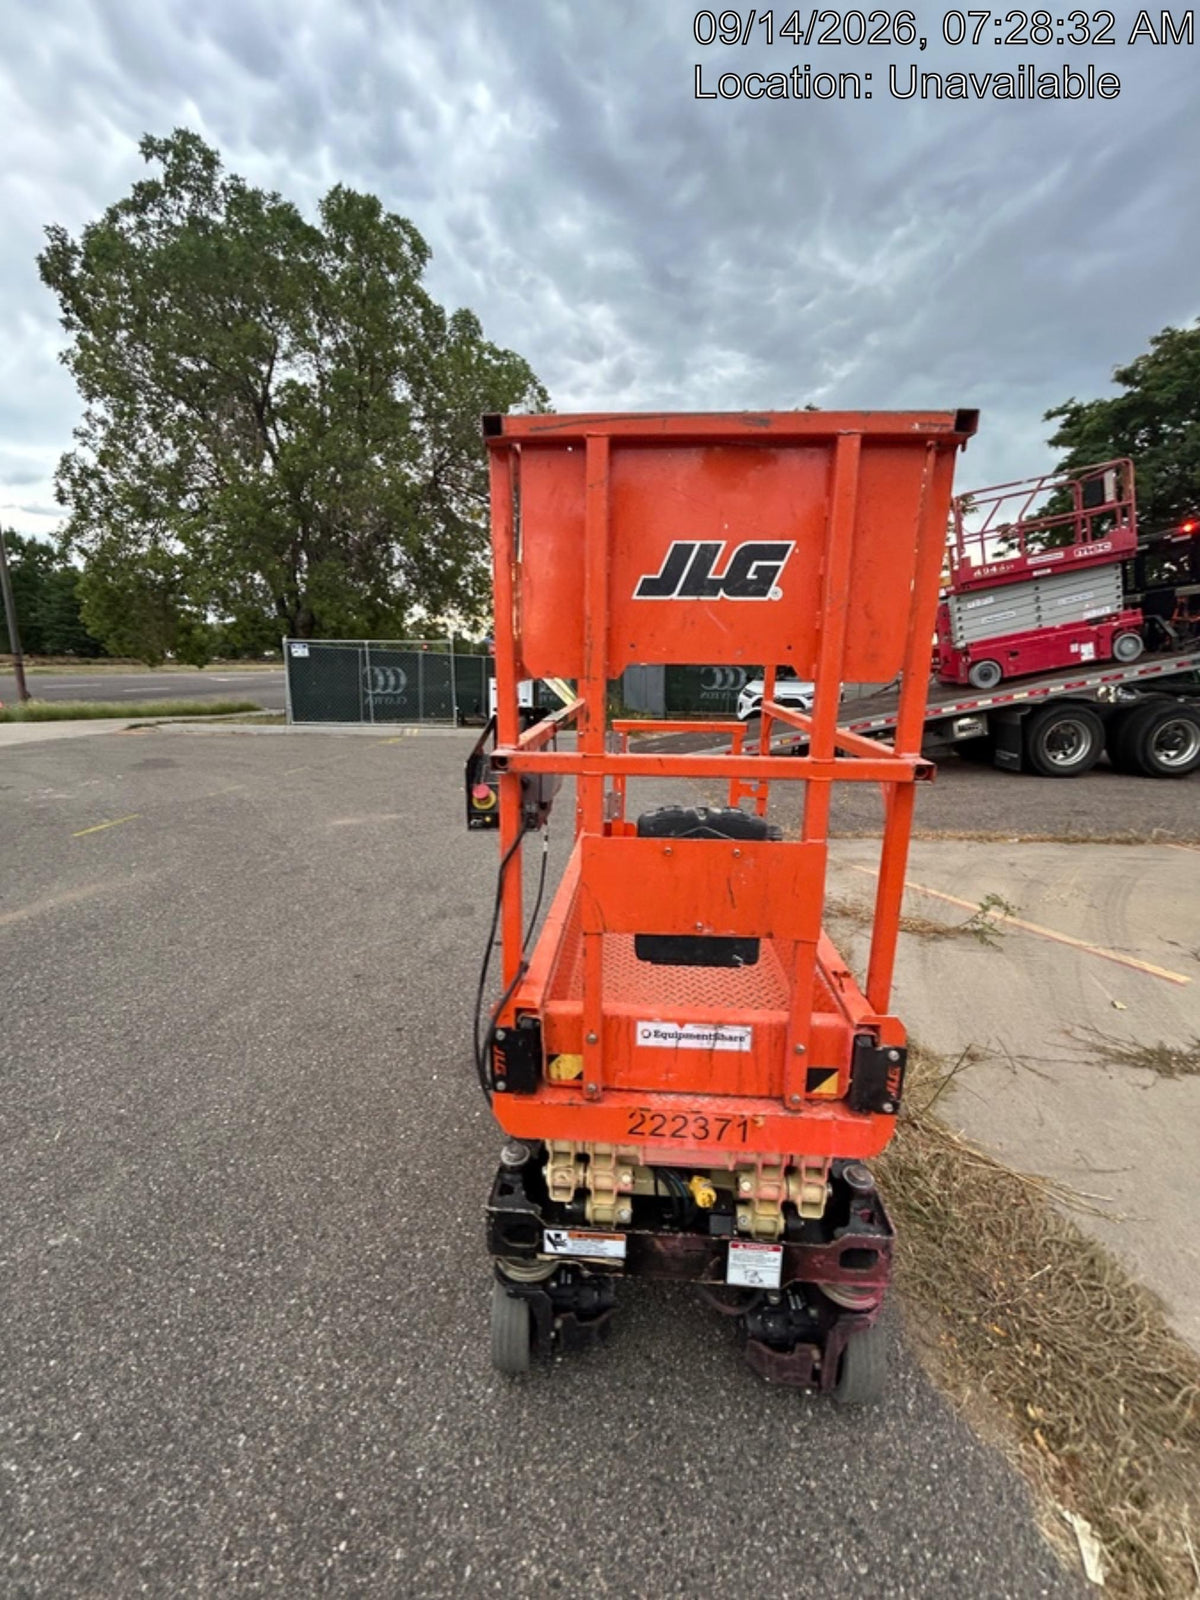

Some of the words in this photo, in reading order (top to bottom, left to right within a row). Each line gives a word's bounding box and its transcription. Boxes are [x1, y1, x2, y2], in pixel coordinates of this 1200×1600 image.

[632, 540, 797, 602] JLG
[653, 1028, 746, 1042] EquipmentShare
[627, 1112, 749, 1143] 222371
